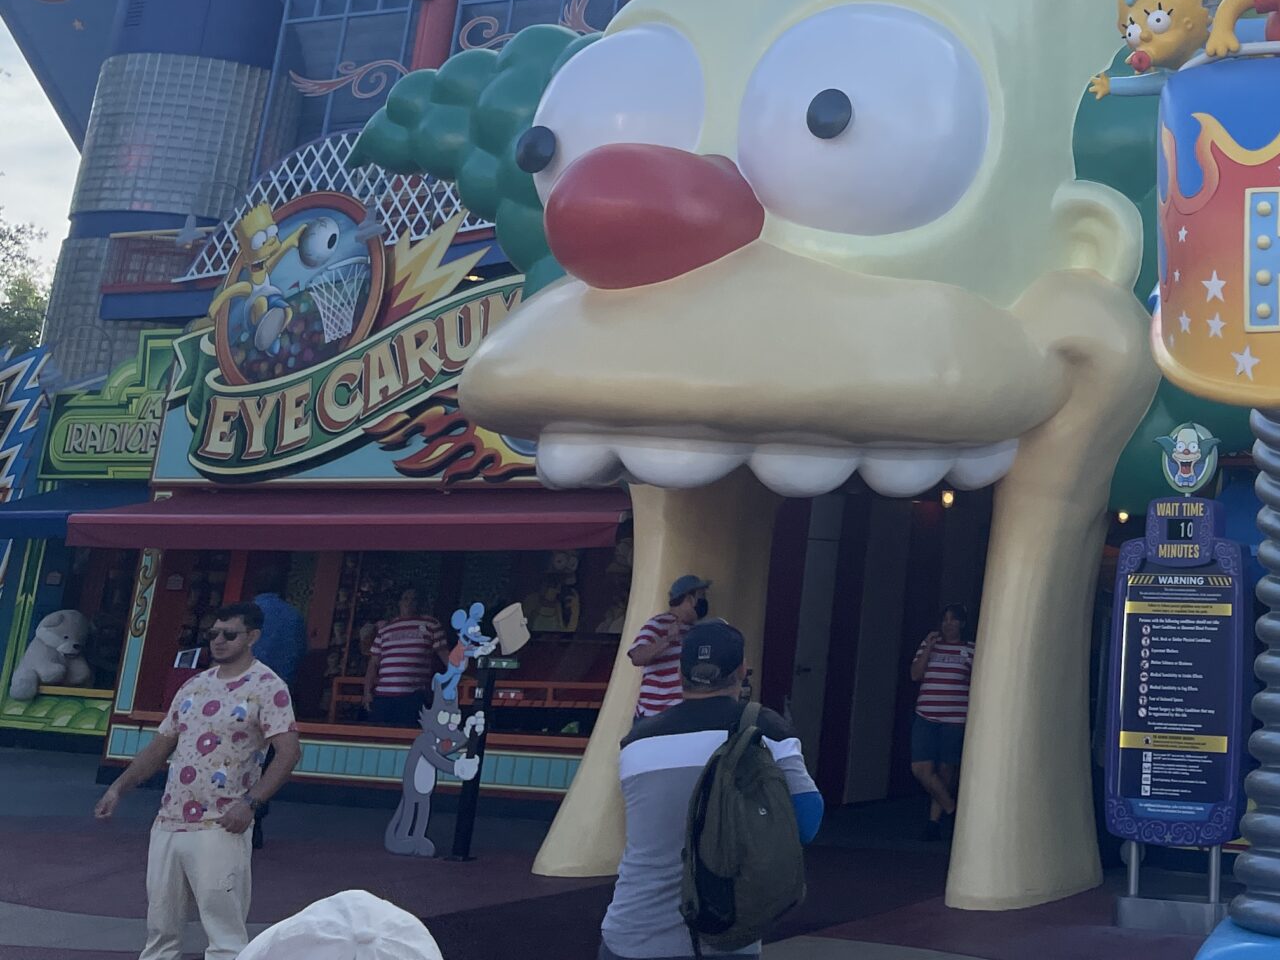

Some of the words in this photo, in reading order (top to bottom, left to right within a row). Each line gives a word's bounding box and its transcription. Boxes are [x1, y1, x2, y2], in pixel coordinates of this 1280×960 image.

[197, 381, 312, 460] EYE
[1156, 502, 1180, 517] WAIT
[1182, 502, 1205, 517] TIME
[1180, 522, 1194, 538] 10
[1158, 544, 1200, 559] MINUTES
[1158, 576, 1205, 586] WARNING
